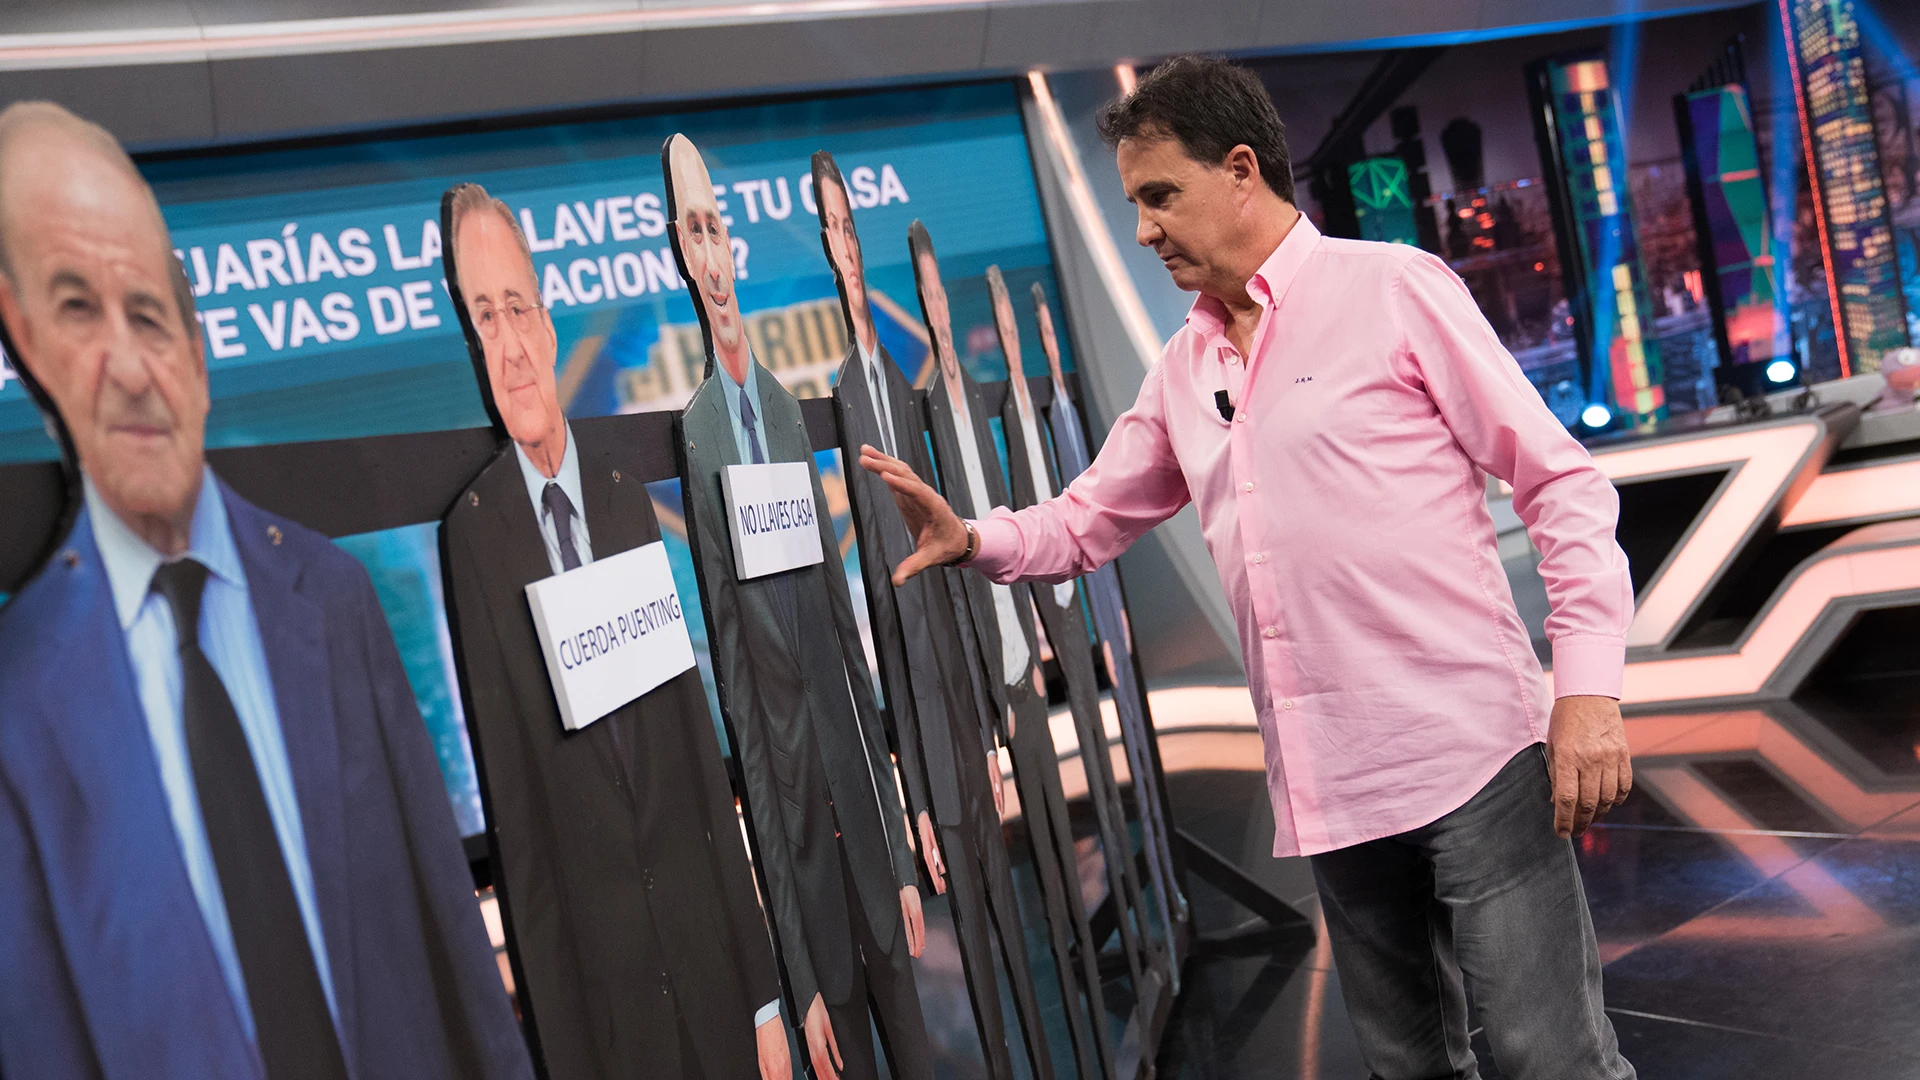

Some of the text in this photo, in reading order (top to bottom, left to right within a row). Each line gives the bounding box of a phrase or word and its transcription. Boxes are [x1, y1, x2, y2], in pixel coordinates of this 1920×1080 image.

[172, 222, 377, 298] JARÍAS
[383, 219, 445, 273] LA
[519, 193, 666, 253] LAVES
[733, 176, 793, 223] TU
[799, 164, 910, 216] CSA
[247, 292, 361, 351] VAS
[366, 280, 441, 336] DE
[739, 498, 814, 535] NO LLAVES CASA
[559, 593, 681, 670] CUERDA PUENTING
